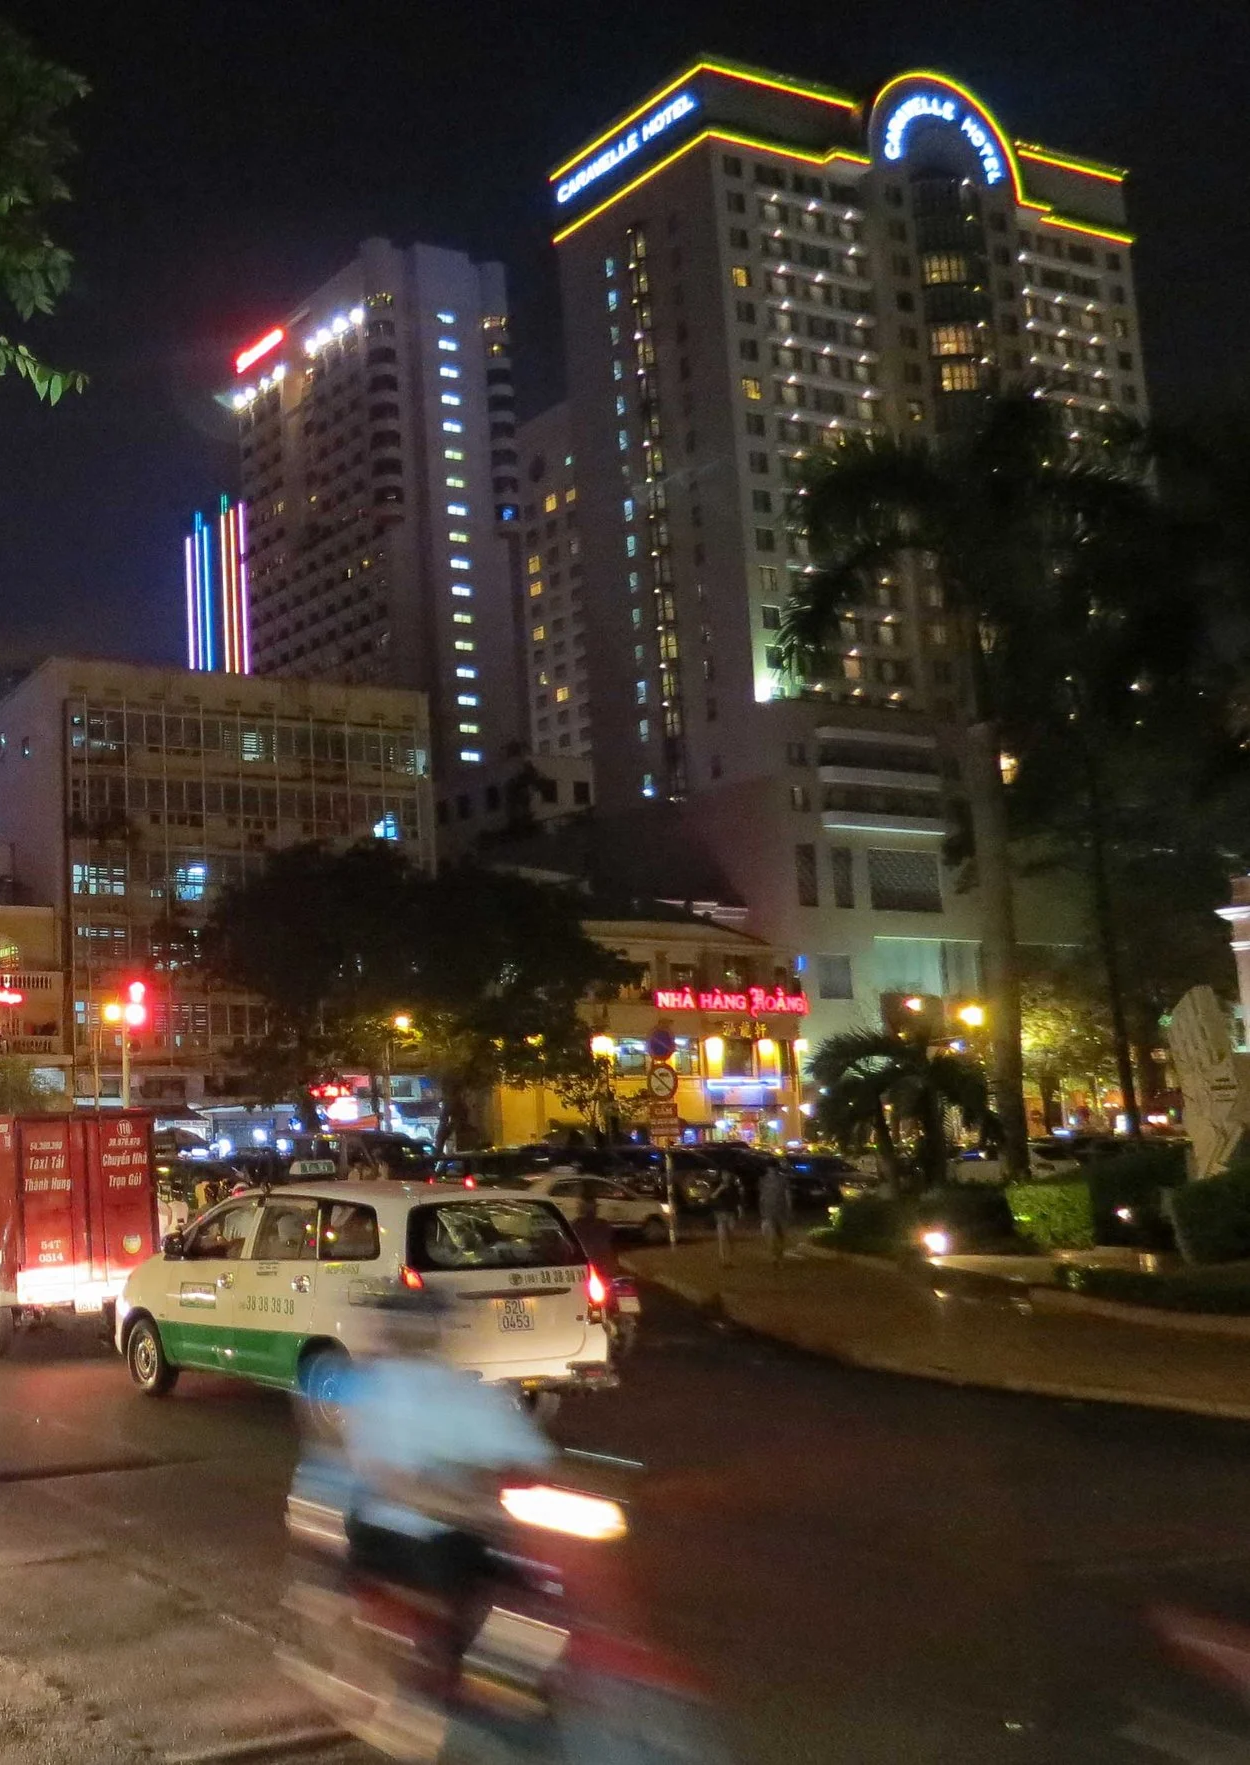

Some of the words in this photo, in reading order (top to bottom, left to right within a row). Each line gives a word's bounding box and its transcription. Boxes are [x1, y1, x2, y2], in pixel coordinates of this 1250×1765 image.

[556, 130, 639, 203] CARAVELLE
[642, 94, 695, 142] HOTEL
[961, 116, 1003, 185] HOTEL
[656, 986, 695, 1009] NHÀ
[700, 988, 746, 1011] HÀNG
[30, 1156, 48, 1170] Taxi
[39, 1254, 64, 1263] 0514
[502, 1315, 530, 1329] 0453
